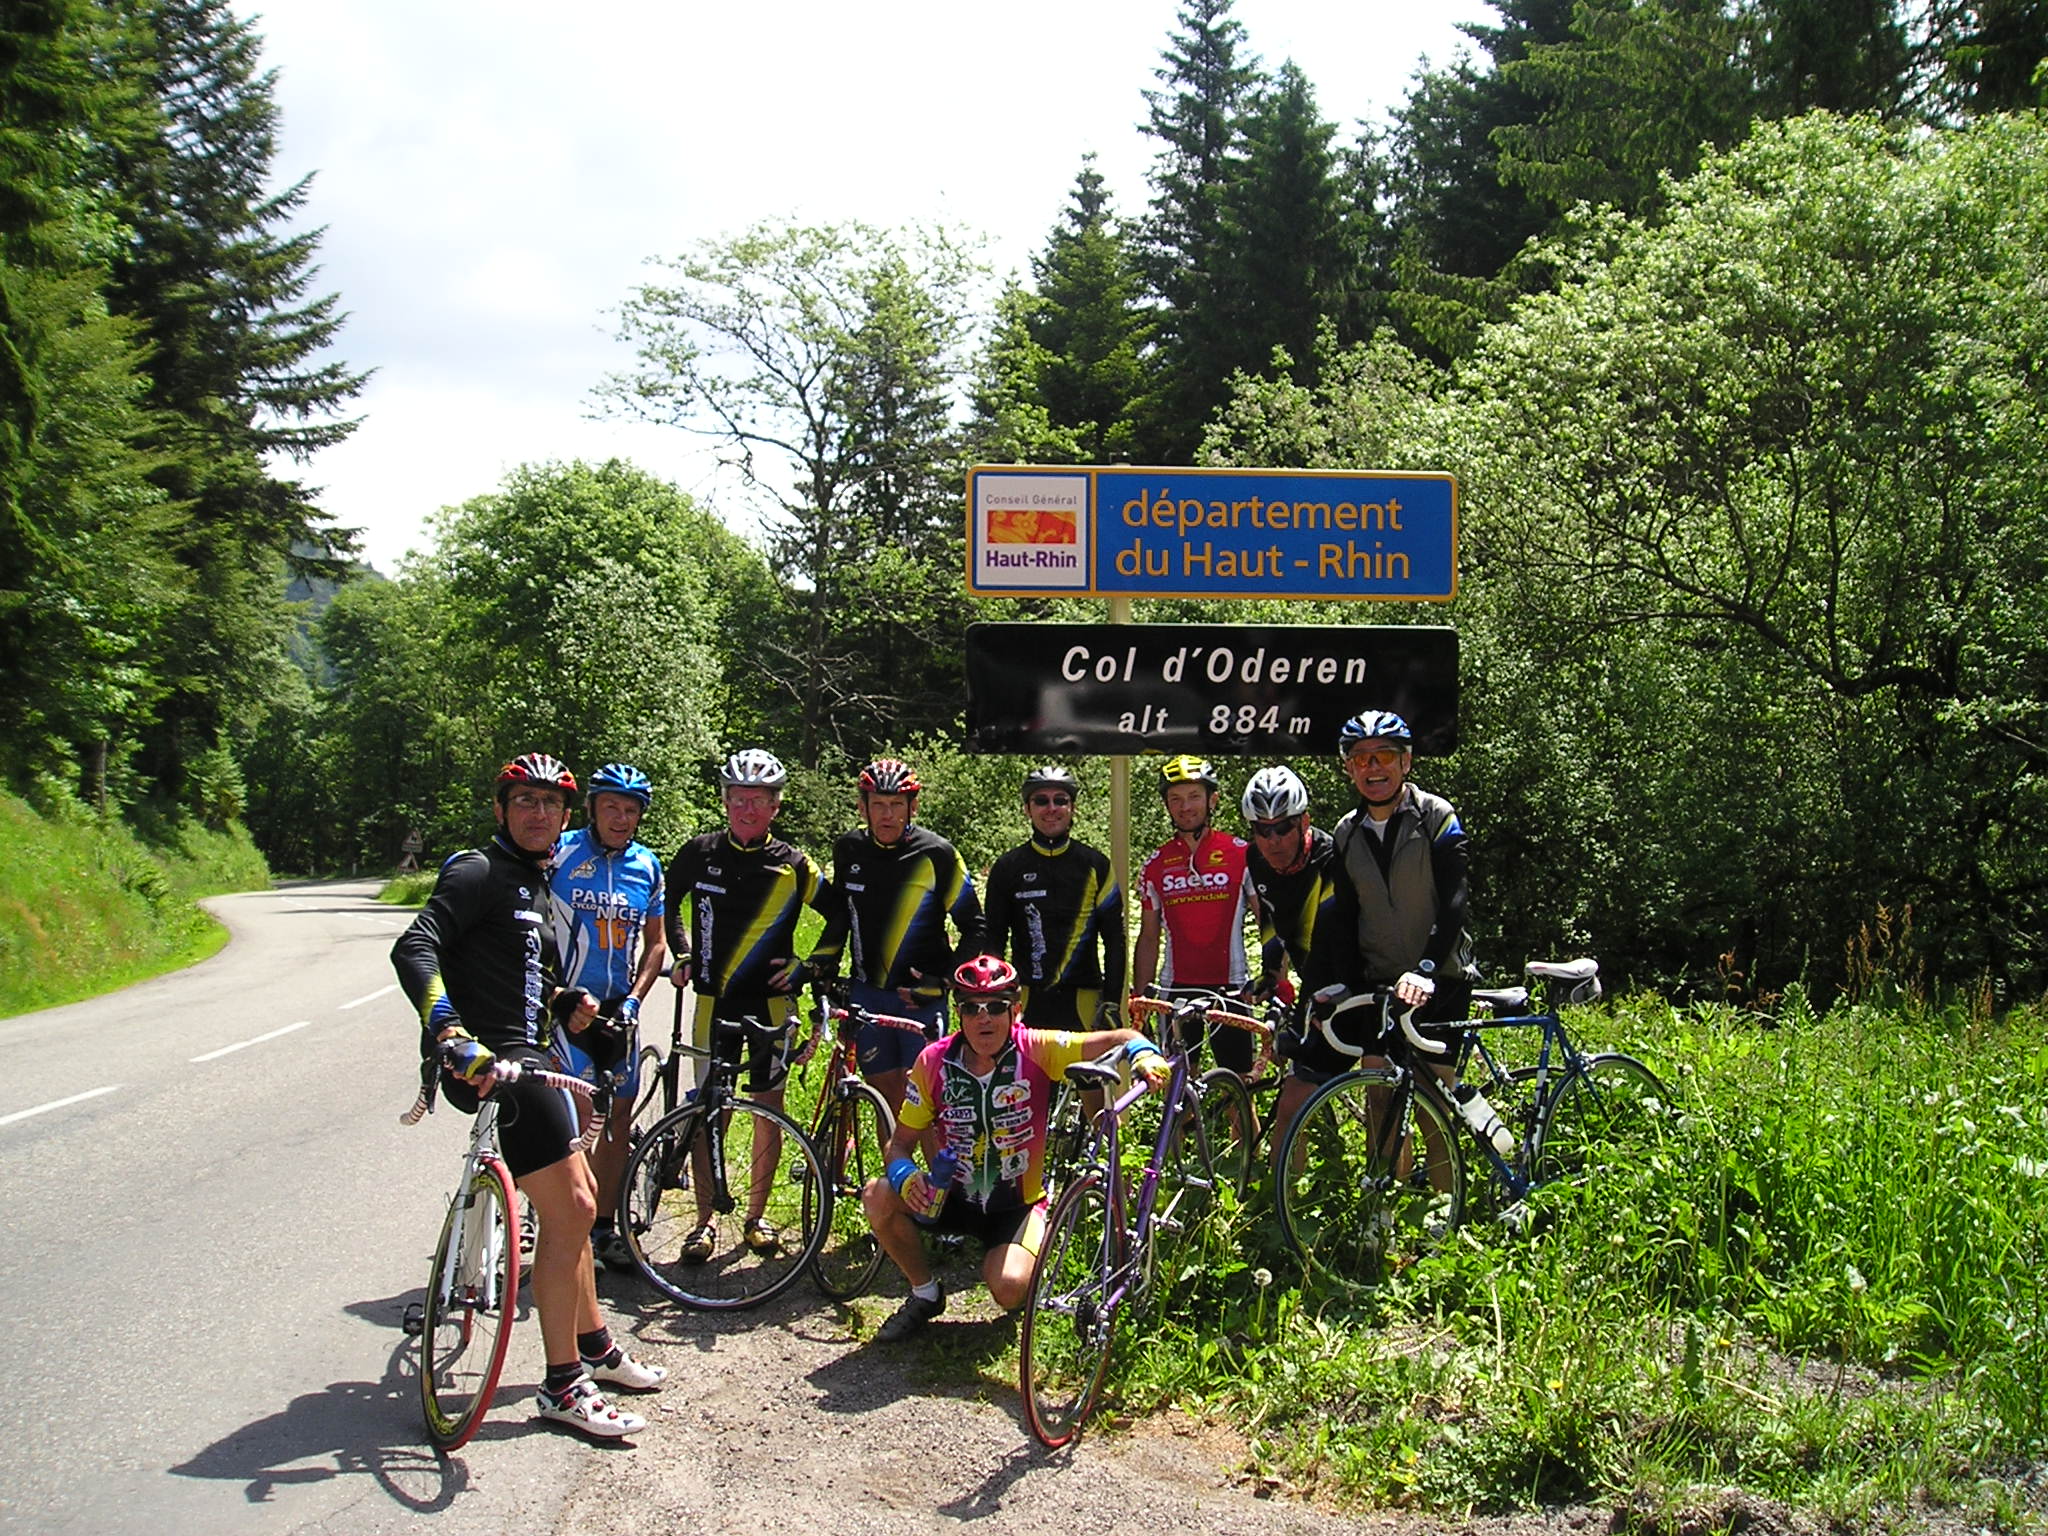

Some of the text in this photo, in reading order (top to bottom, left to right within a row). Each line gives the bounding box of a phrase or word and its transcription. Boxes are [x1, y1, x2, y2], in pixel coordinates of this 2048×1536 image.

[986, 494, 1077, 505] Conseil Général
[1121, 488, 1403, 536] département
[986, 550, 1077, 568] Haut-Rhin
[1115, 538, 1169, 576] du
[1183, 541, 1284, 577] Haut
[1319, 540, 1410, 579] Rhin
[1061, 645, 1367, 684] Col d'Oderen
[1118, 704, 1312, 735] alt 884 m
[1162, 872, 1230, 892] Saeco
[571, 888, 629, 906] PARIS
[571, 902, 598, 911] CYCLO
[596, 906, 639, 921] NICE
[594, 919, 627, 950] 16
